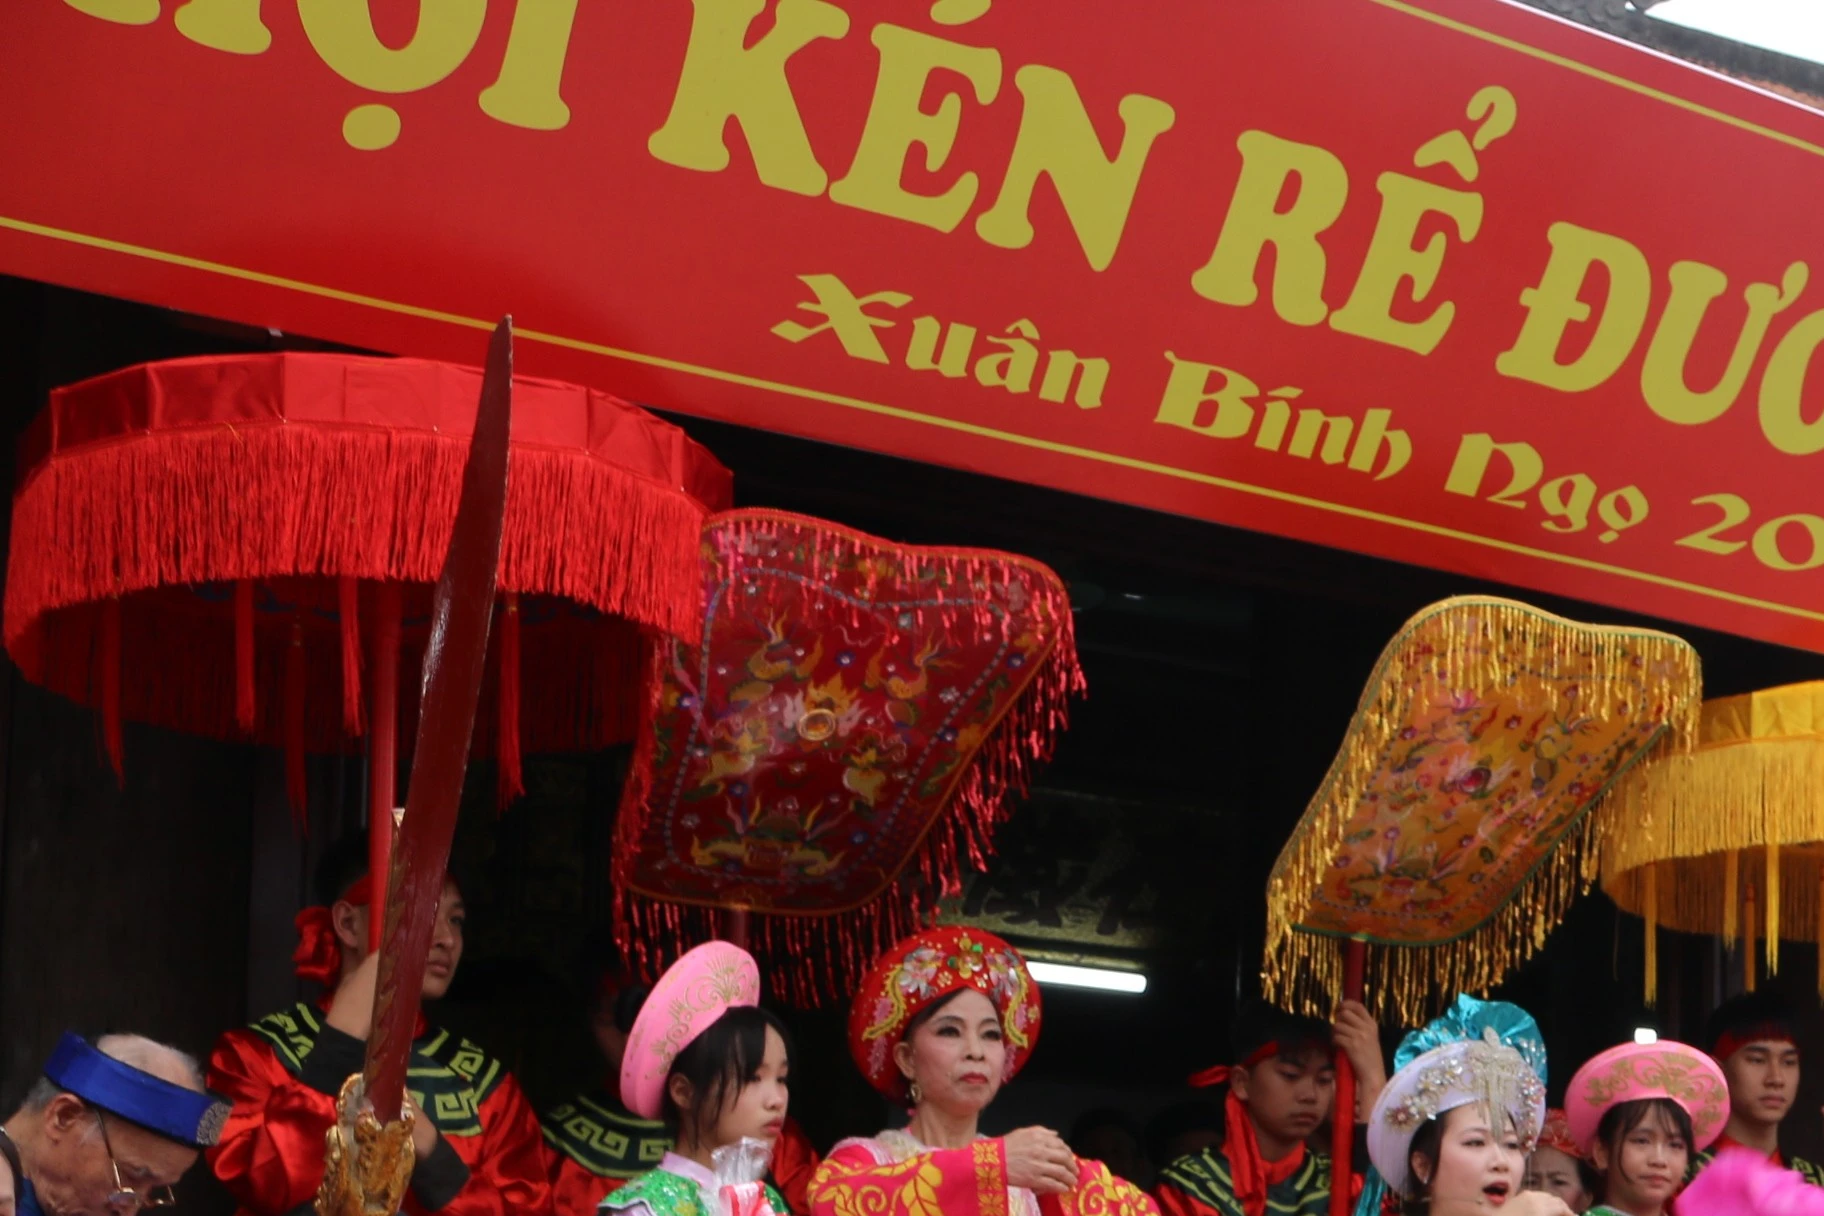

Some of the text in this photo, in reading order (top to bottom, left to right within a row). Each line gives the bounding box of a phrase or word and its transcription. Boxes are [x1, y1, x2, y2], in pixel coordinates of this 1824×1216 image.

[1192, 86, 1516, 355] RỂ
[772, 274, 1109, 408] Xuân
[1156, 352, 1411, 479] Bính
[1446, 434, 1648, 545] Ngọ
